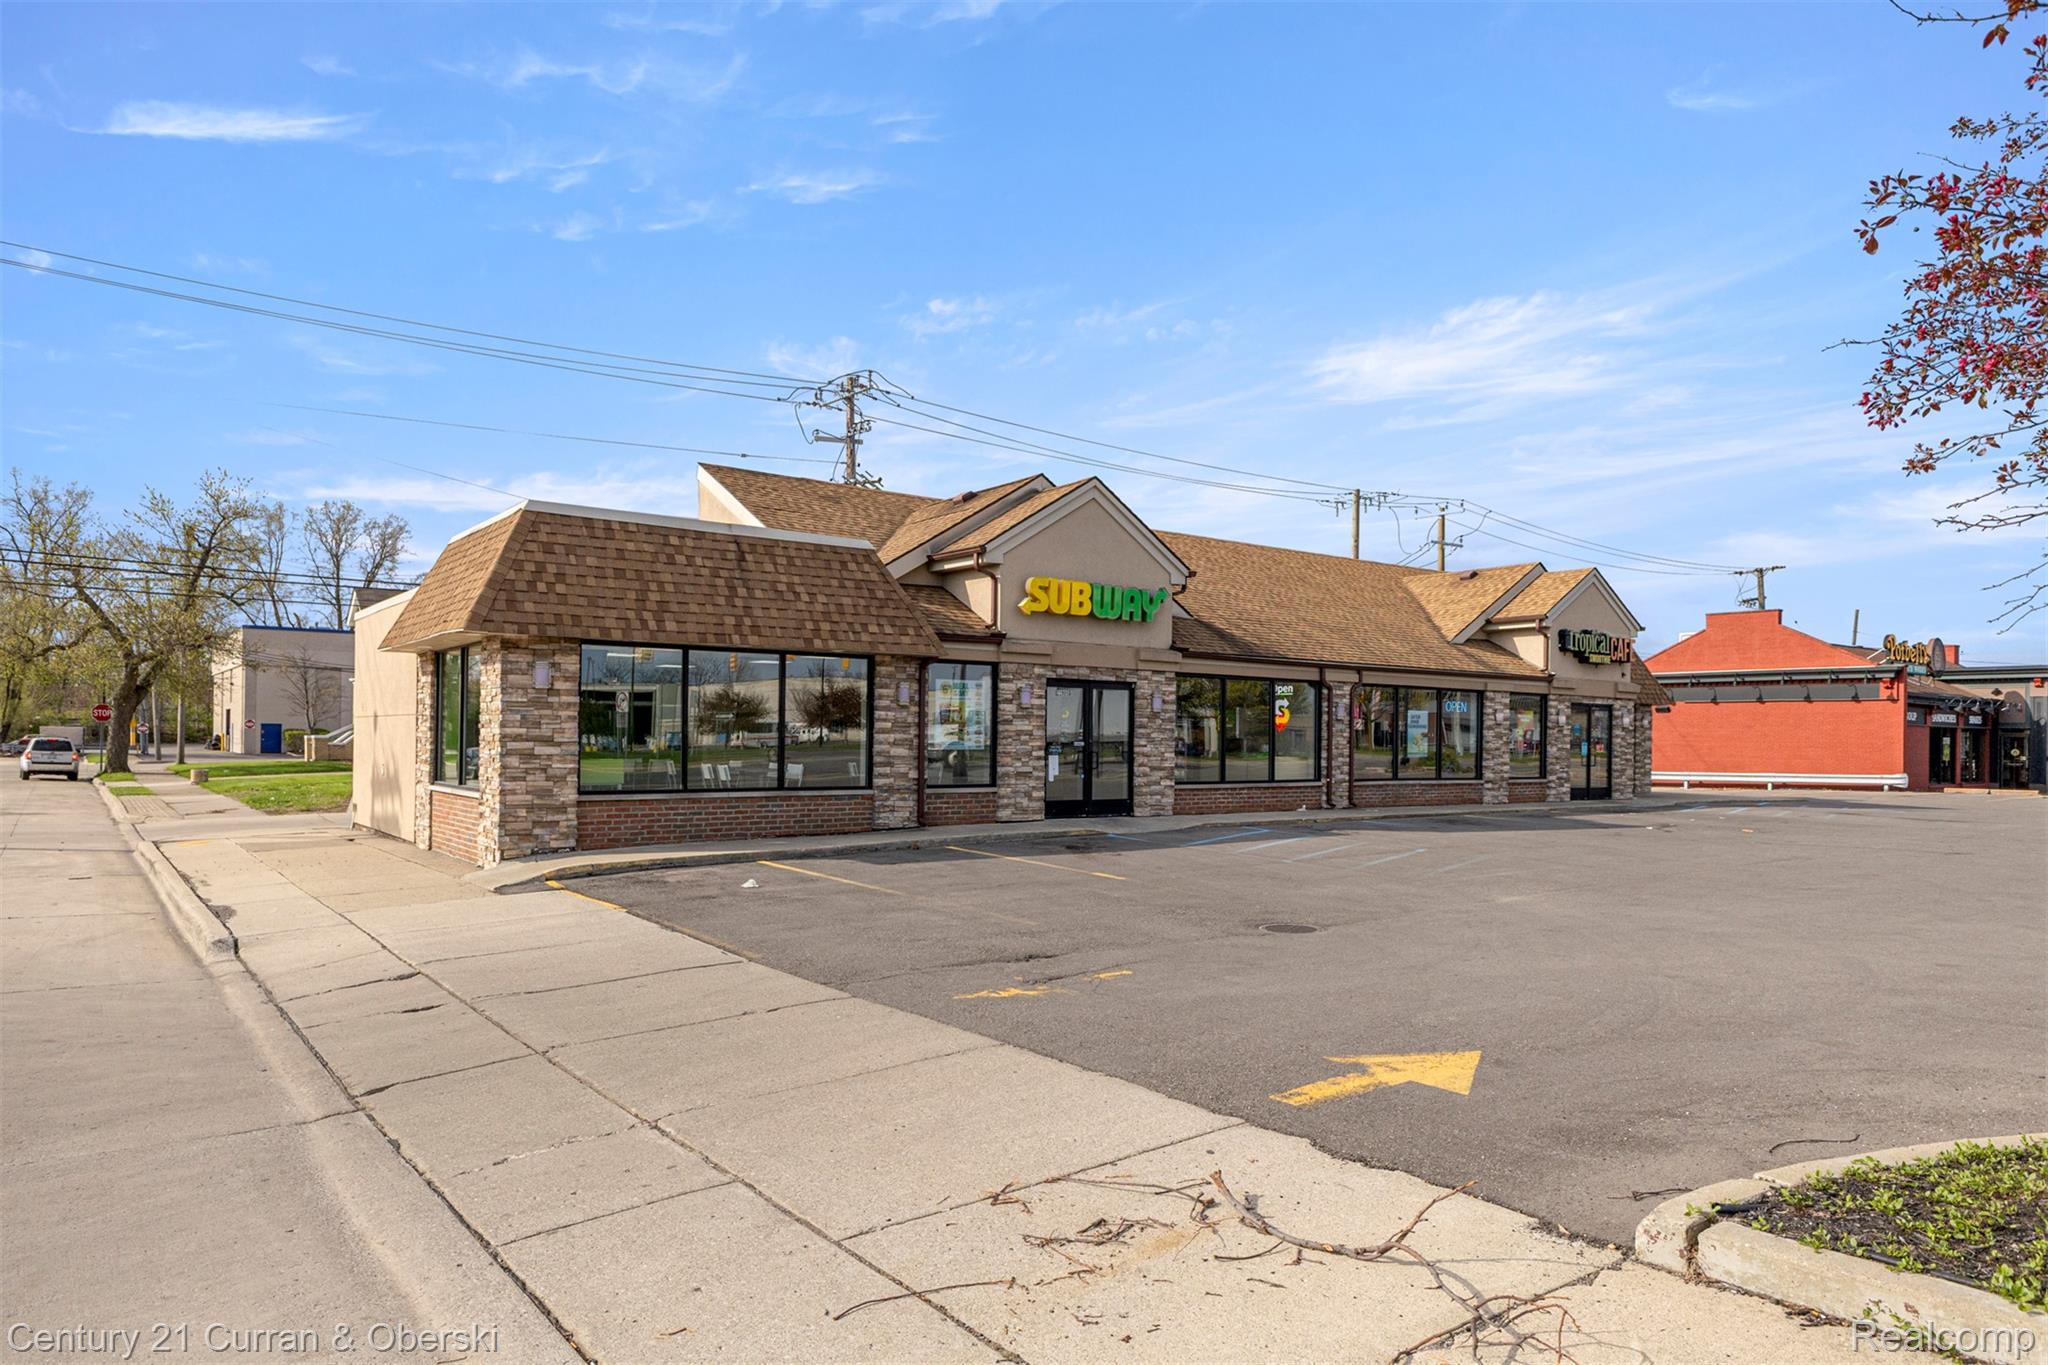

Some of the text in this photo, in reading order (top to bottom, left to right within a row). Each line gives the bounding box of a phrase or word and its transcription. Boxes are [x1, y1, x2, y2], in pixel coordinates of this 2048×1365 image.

[1018, 576, 1168, 622] SUBWAY
[93, 709, 112, 717] STOP
[1445, 701, 1468, 713] OPEN
